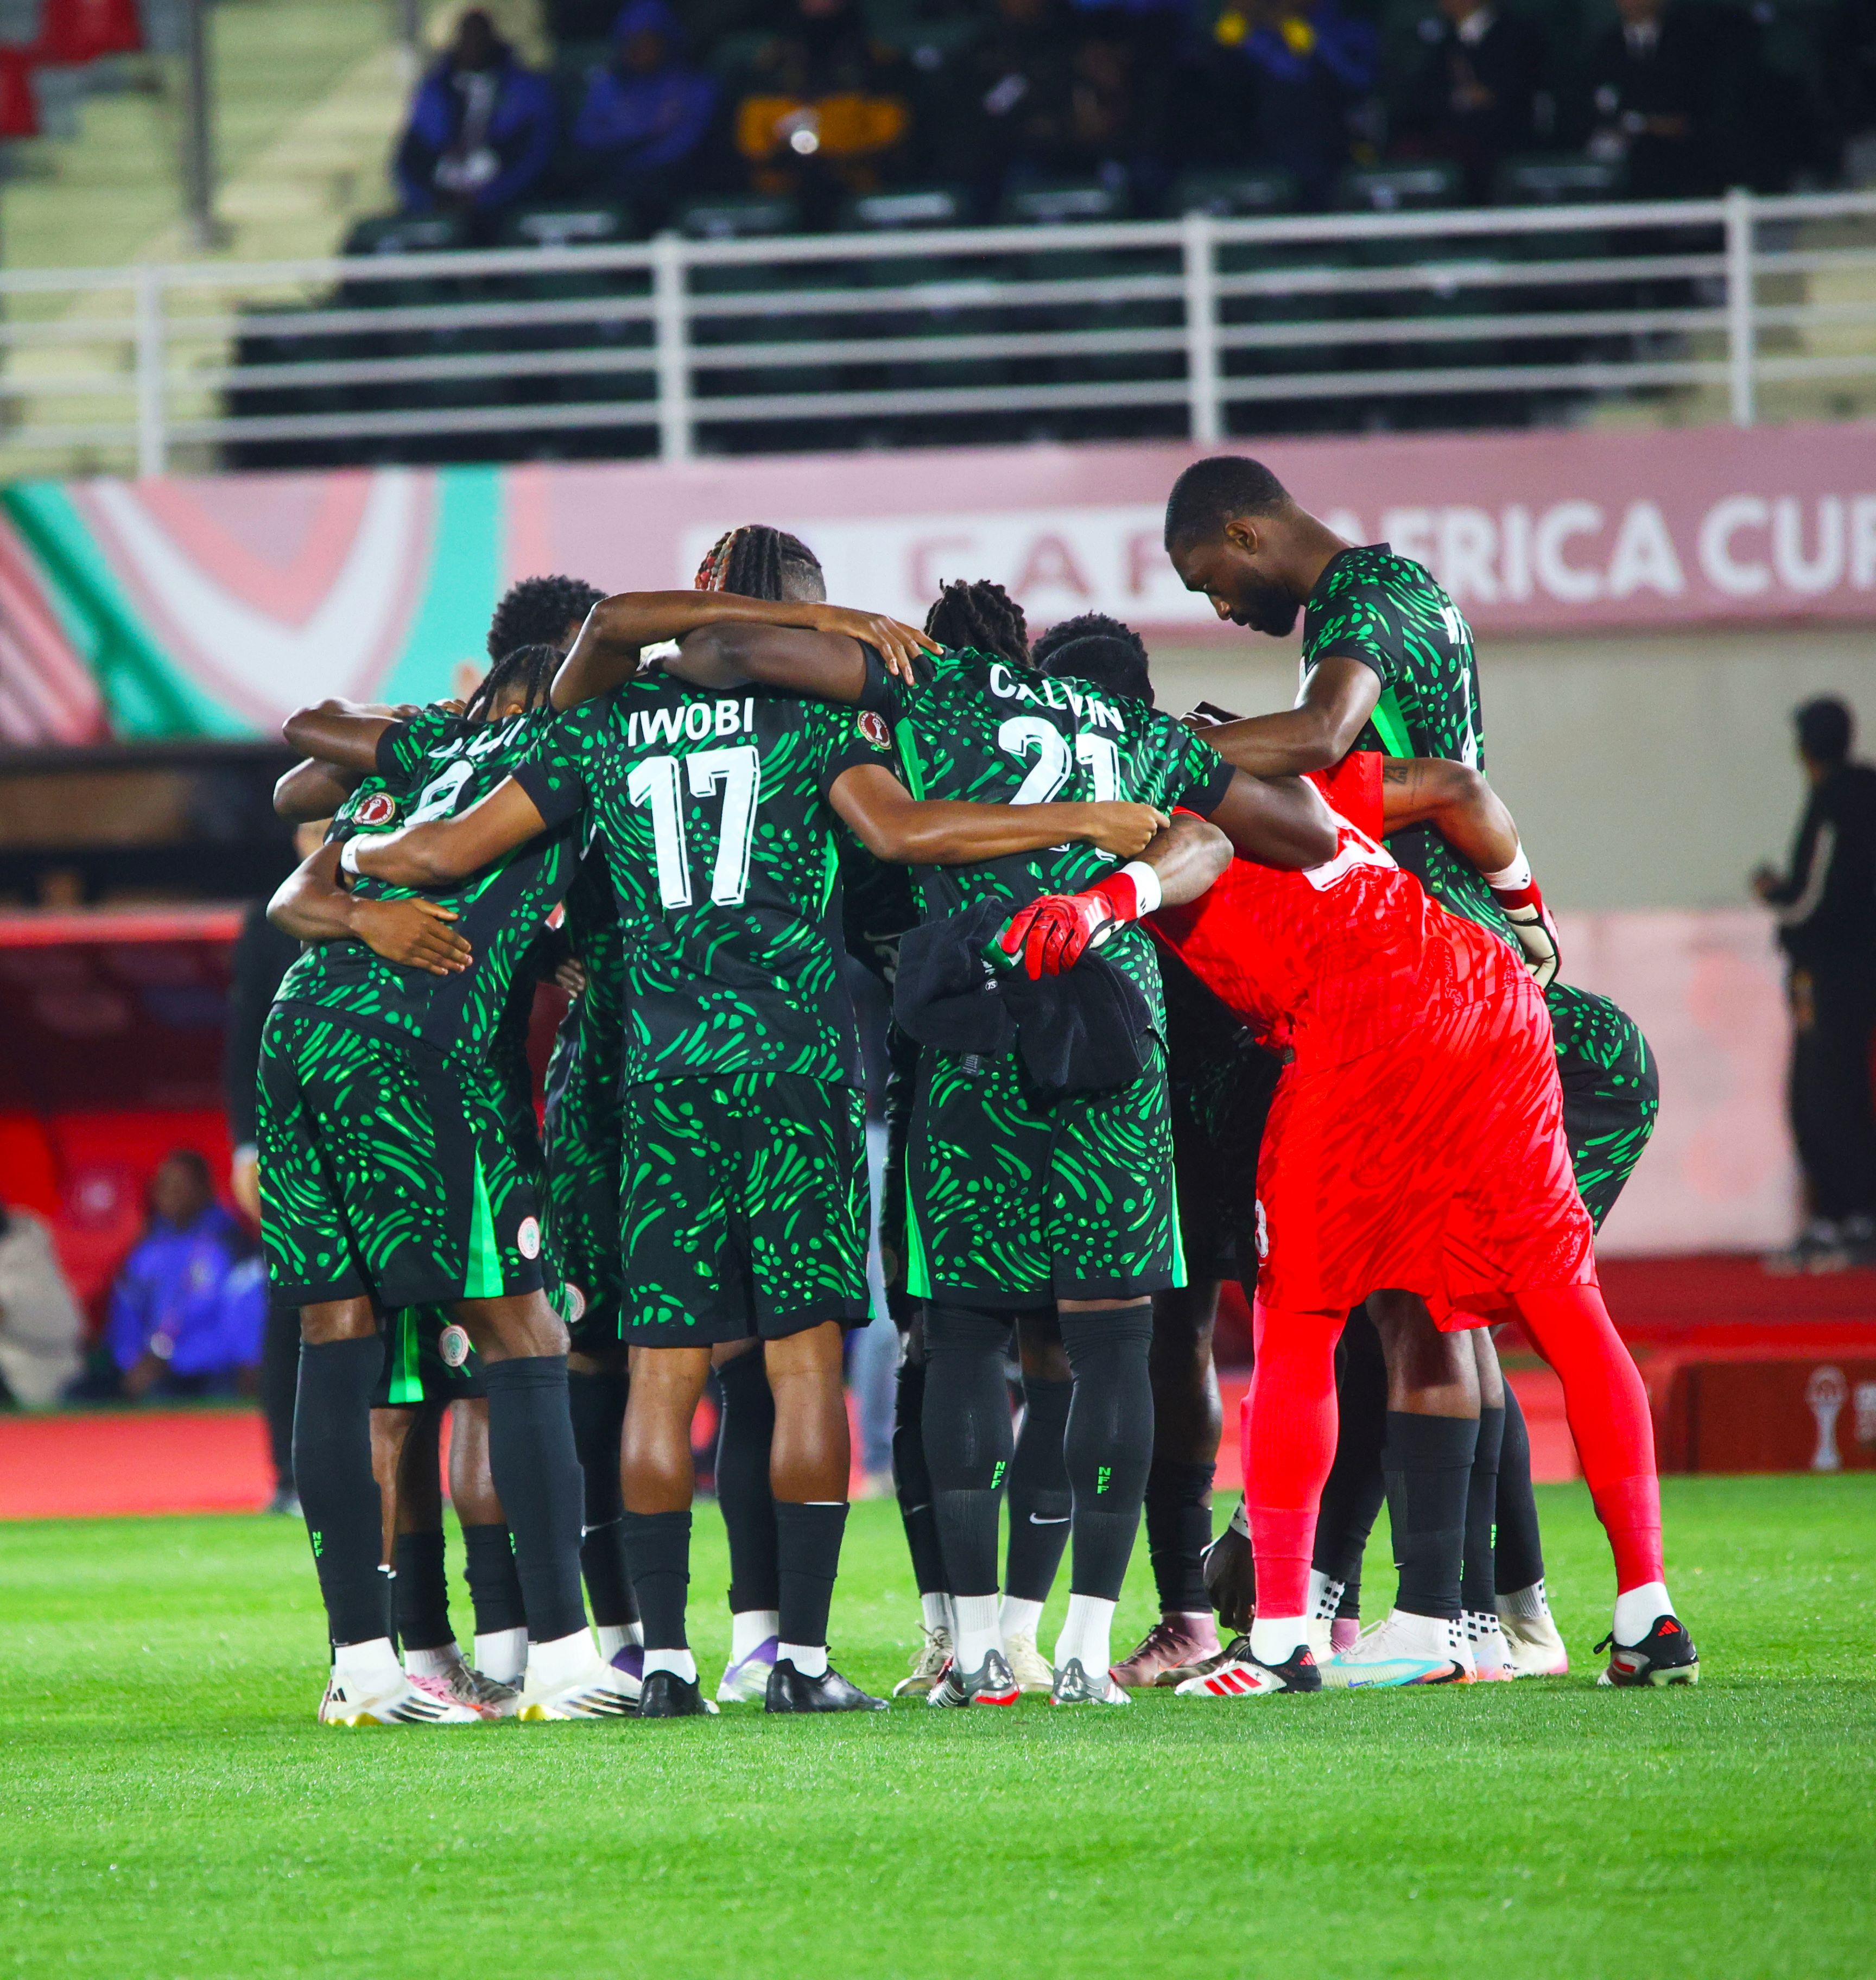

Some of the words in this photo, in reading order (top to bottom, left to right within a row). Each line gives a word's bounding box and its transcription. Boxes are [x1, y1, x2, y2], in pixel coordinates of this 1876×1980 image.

[628, 697, 754, 746] IWOBI
[627, 745, 760, 910] 17
[991, 1461, 1006, 1489] NFF
[1097, 1466, 1111, 1494] NFF
[312, 1531, 324, 1558] NFF
